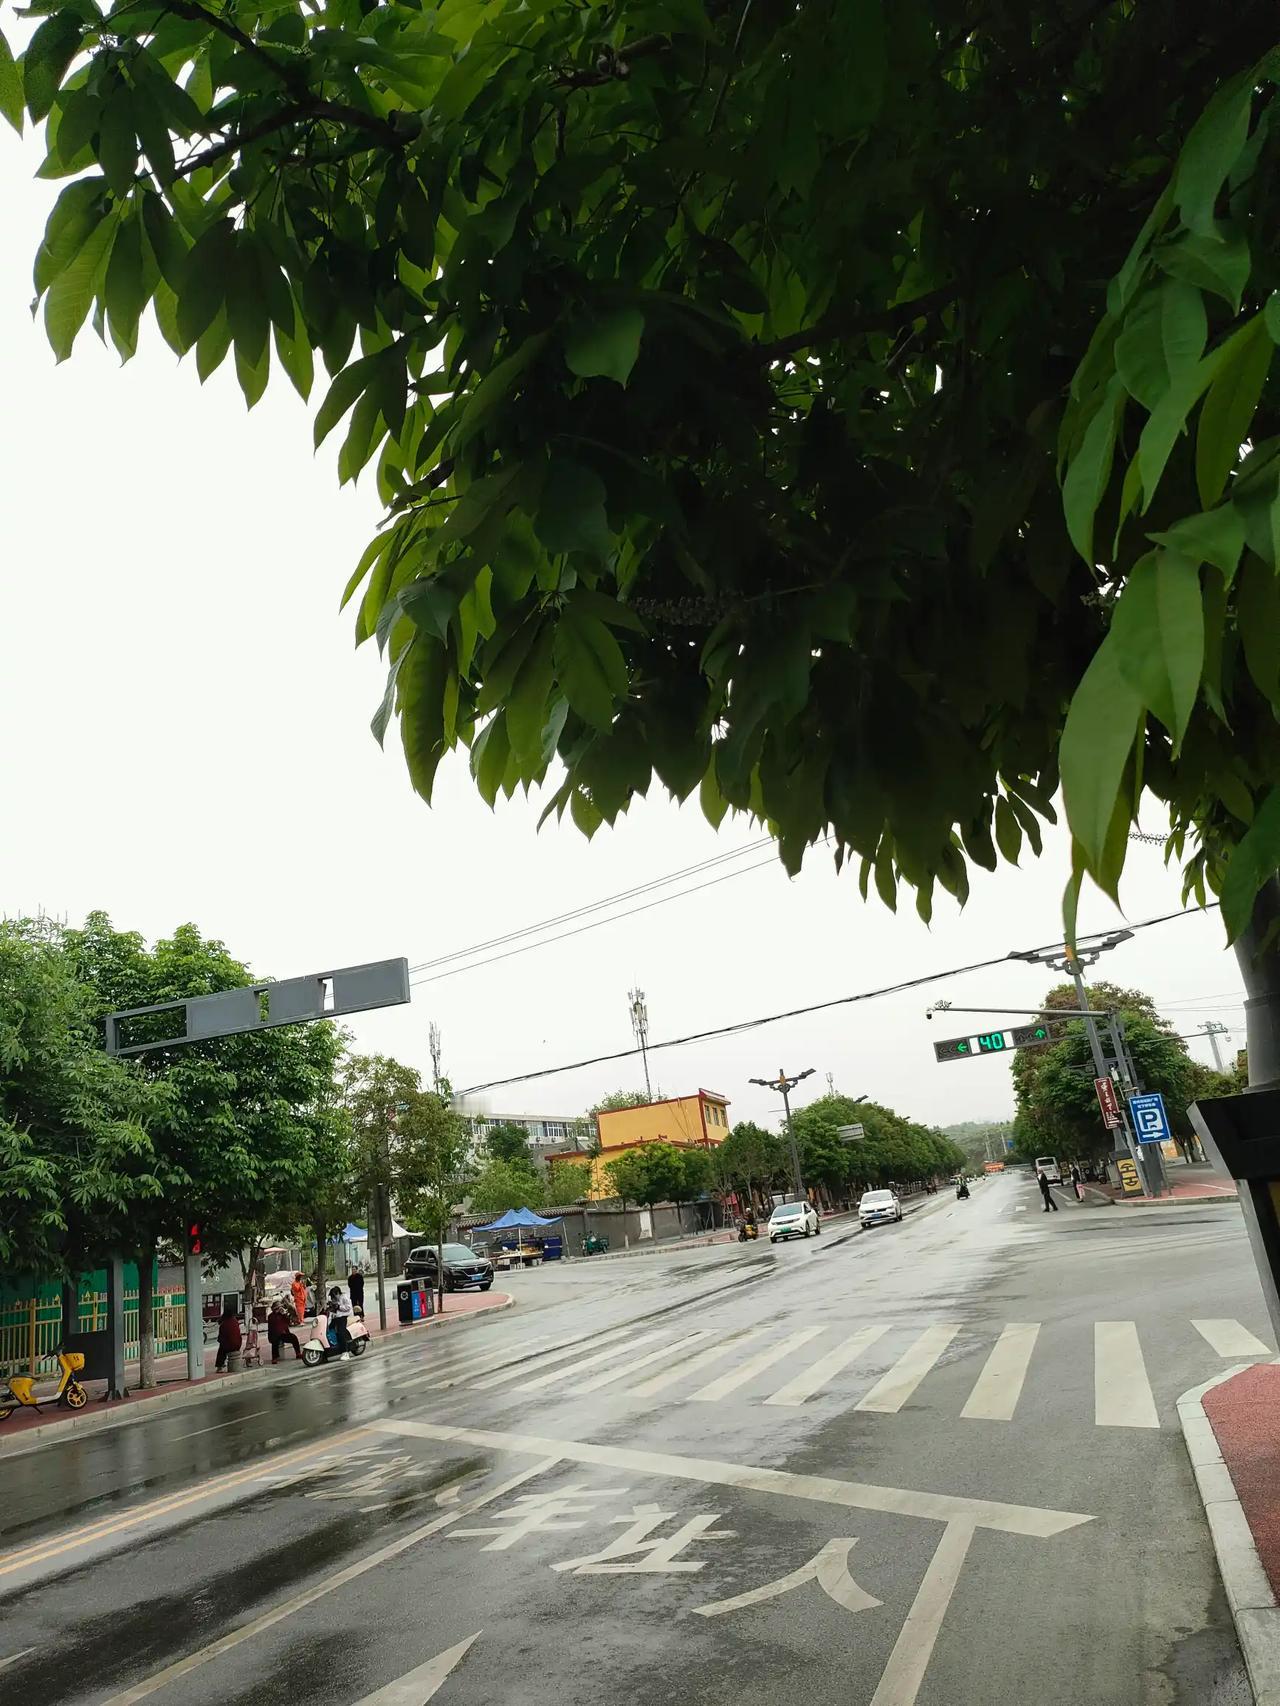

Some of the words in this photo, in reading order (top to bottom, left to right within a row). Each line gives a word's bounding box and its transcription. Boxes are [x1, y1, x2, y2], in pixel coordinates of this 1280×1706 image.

[979, 1032, 1003, 1050] 40
[1141, 1111, 1158, 1130] P
[445, 1483, 885, 1617] 车让人
